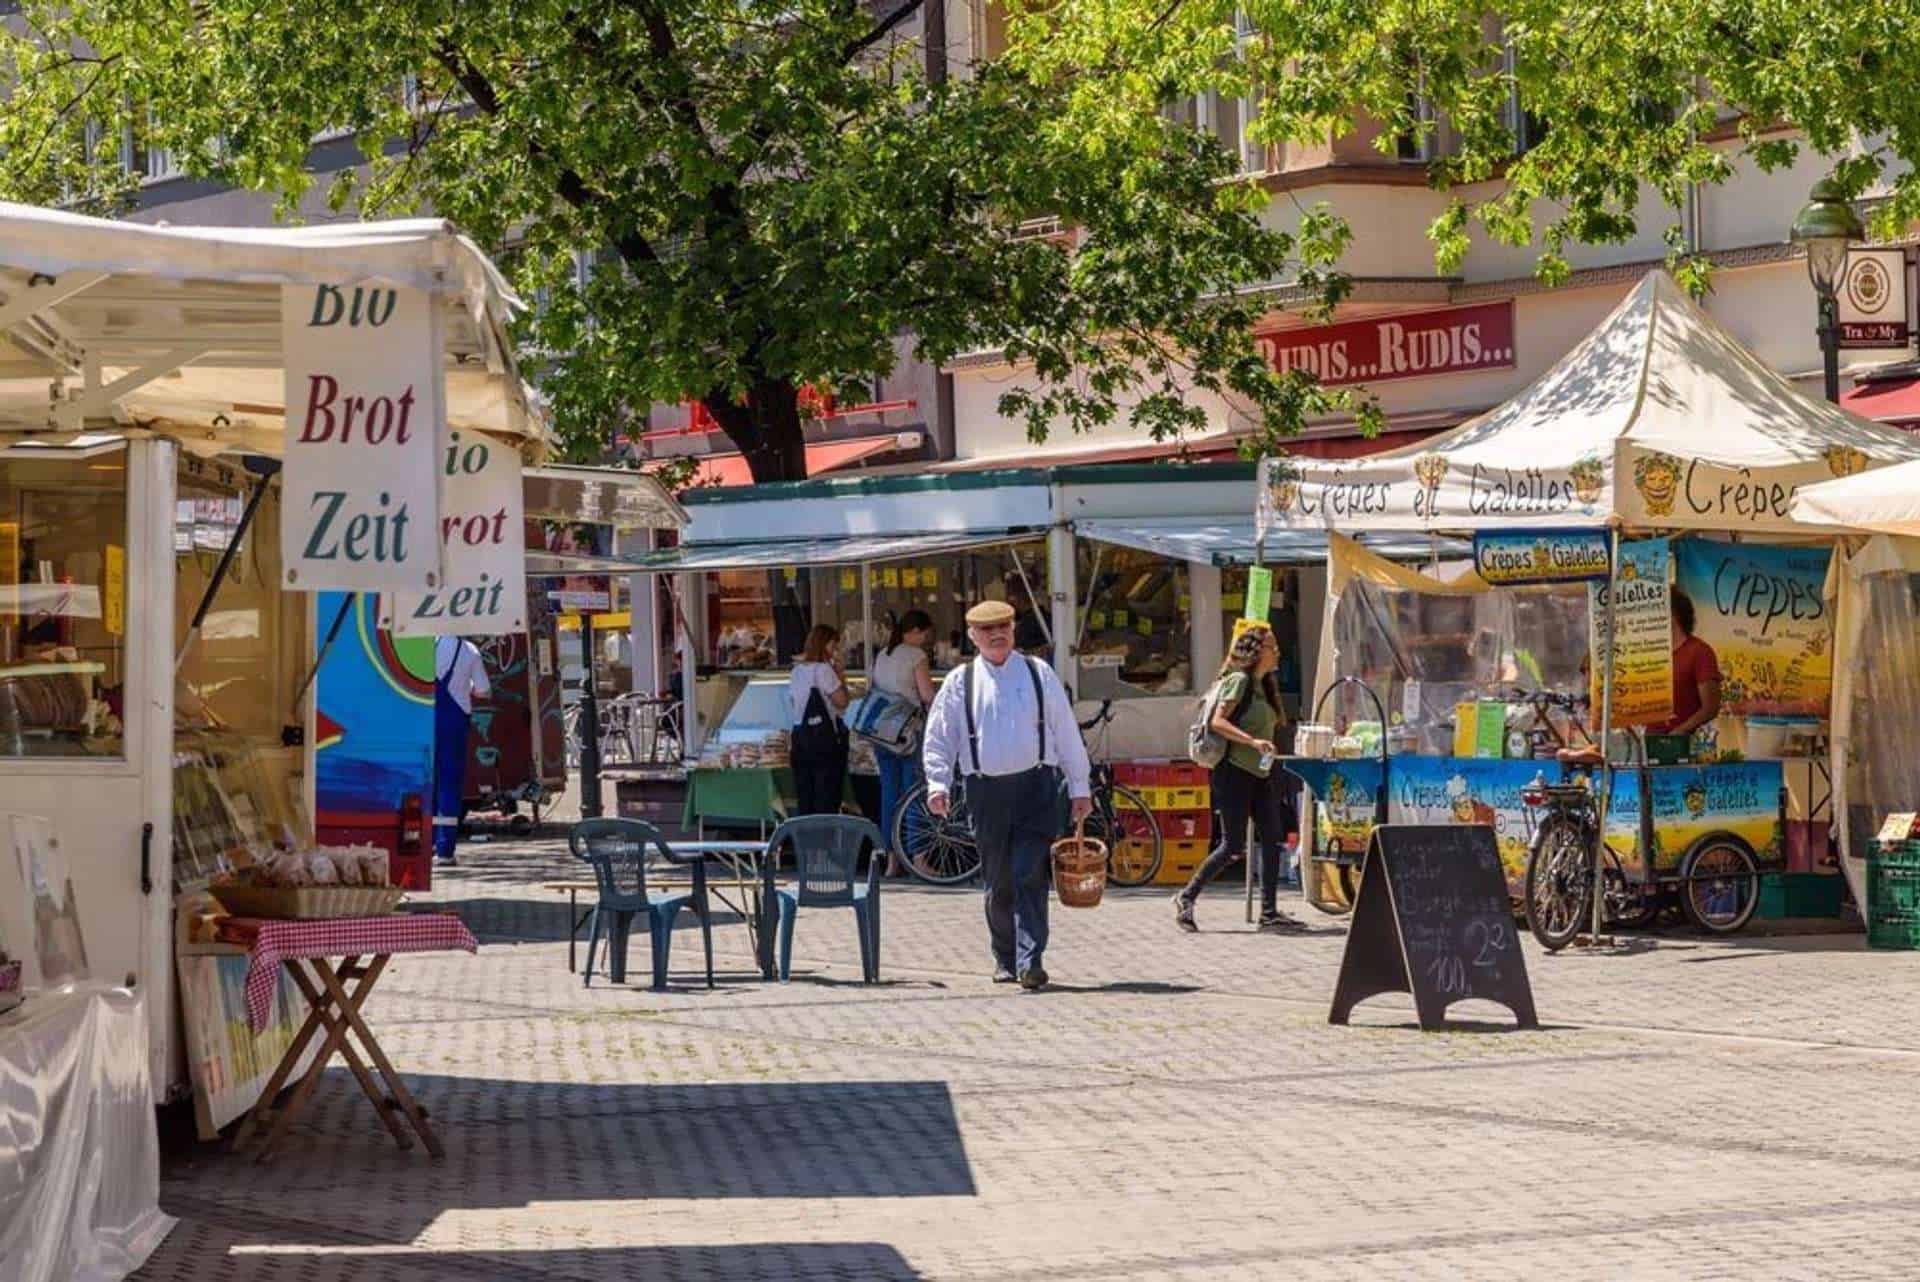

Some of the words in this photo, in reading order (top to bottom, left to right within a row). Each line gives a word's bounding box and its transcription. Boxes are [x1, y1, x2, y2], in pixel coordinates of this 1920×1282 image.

[297, 375, 415, 446] Brot
[445, 431, 490, 476] io
[1300, 467, 1392, 518] Crêpes
[1469, 462, 1573, 516] Galettes
[303, 491, 410, 563] Zeit
[441, 507, 507, 546] rot
[1552, 543, 1606, 568] Galettes
